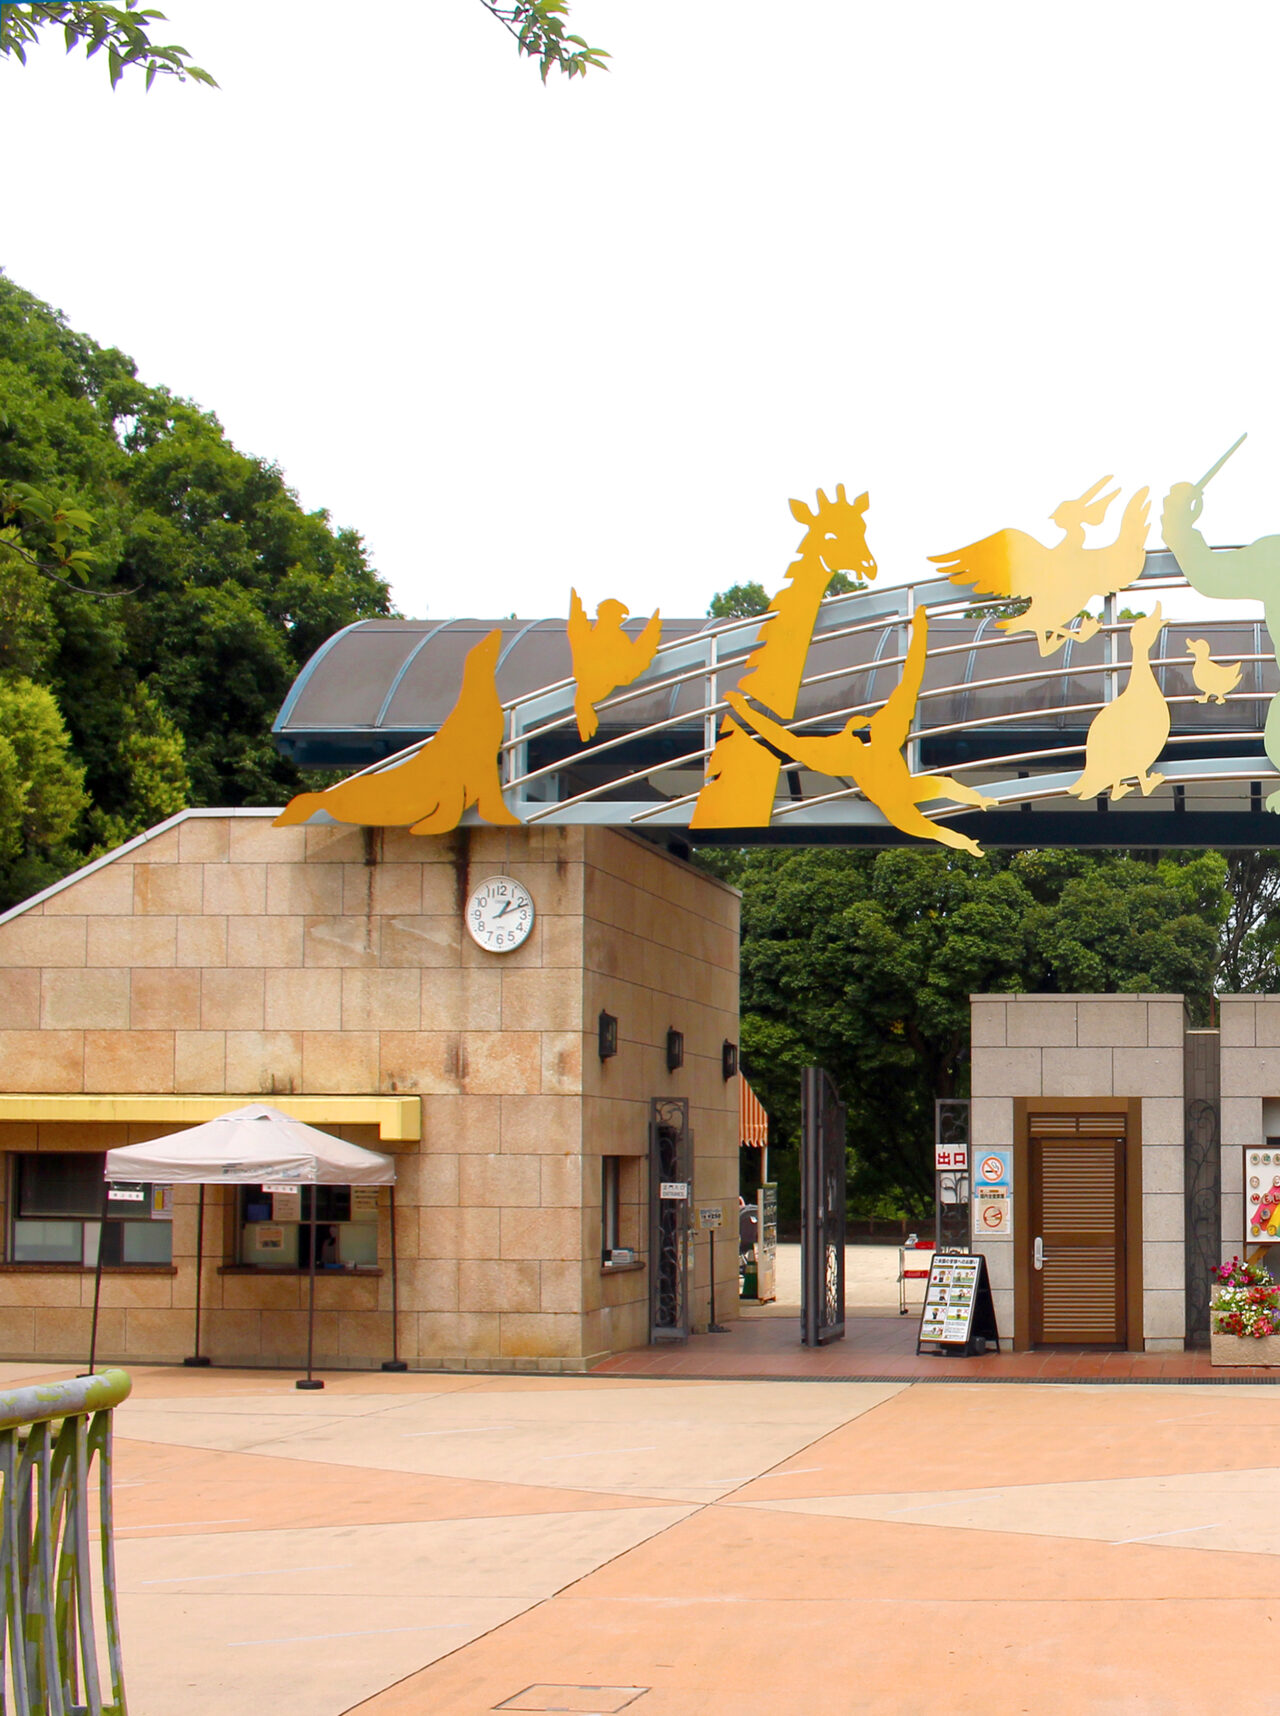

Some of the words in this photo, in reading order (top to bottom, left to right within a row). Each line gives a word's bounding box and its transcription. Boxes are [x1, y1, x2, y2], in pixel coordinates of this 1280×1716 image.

[486, 885, 495, 898] 11
[497, 885, 507, 896] 12
[475, 897, 487, 907] 10
[474, 910, 481, 920] 9
[520, 910, 527, 920] 3
[478, 921, 485, 931] 8
[516, 922, 523, 932] 4
[486, 931, 494, 941] 7
[496, 933, 504, 944] 6
[508, 931, 515, 941] 5
[938, 1152, 965, 1165] 出口
